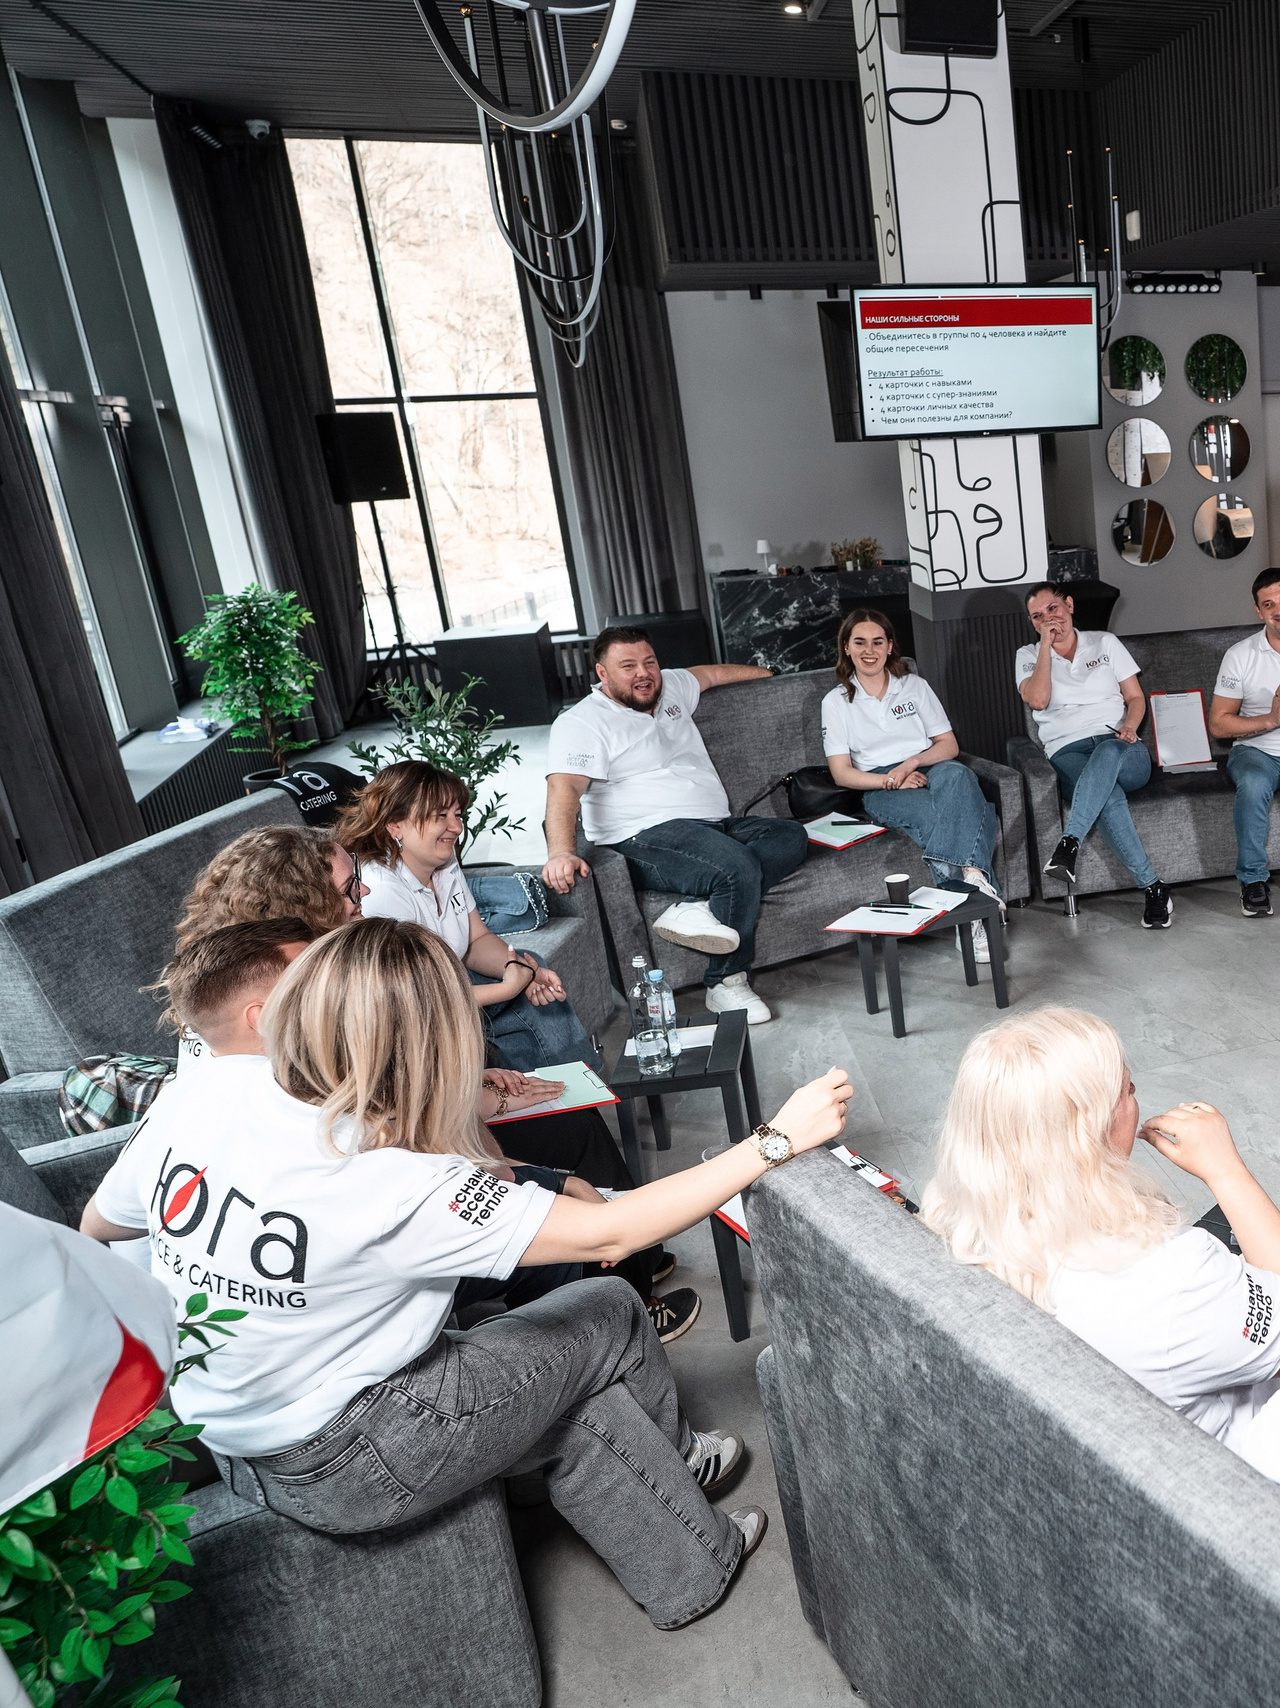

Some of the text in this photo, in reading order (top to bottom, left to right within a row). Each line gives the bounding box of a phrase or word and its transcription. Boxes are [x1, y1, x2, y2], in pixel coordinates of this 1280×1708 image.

[890, 315, 924, 323] СИЛЬНЫЕ
[869, 332, 931, 341] Объединитесь
[989, 330, 1025, 338] человека
[866, 344, 949, 353] общие пересечения
[868, 368, 943, 377] Результат работы:
[886, 380, 923, 390] карточки
[887, 392, 924, 401] карточки
[933, 390, 997, 400] супер-знаниями
[887, 404, 925, 413] карточки
[917, 415, 951, 423] полезны
[953, 414, 968, 422] для
[970, 412, 1012, 420] компании?
[300, 791, 337, 811] CATERING
[459, 1176, 499, 1221] всегда
[471, 1185, 508, 1226] тепло
[151, 1147, 307, 1283] Юга
[173, 1254, 184, 1277] &
[189, 1264, 306, 1308] CATERING
[1242, 1273, 1256, 1338] #снами
[1250, 1284, 1265, 1343] всегда
[1257, 1295, 1273, 1345] тепло
